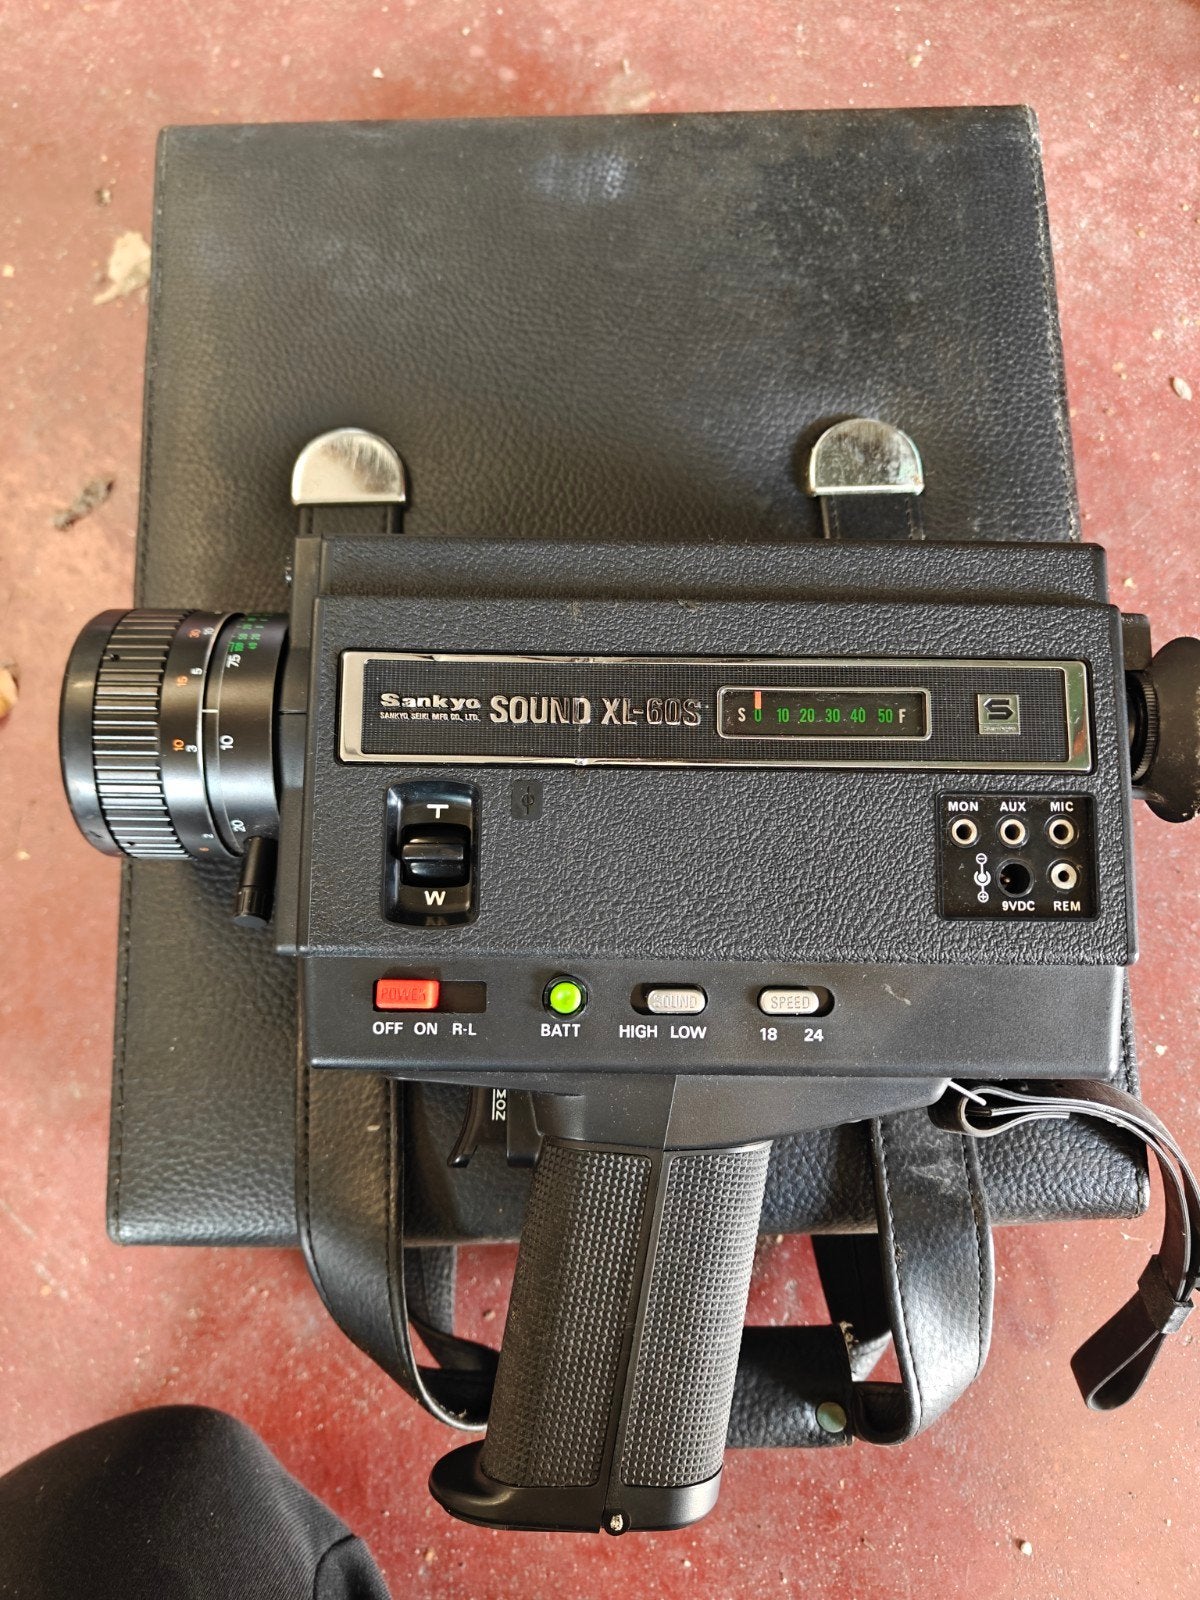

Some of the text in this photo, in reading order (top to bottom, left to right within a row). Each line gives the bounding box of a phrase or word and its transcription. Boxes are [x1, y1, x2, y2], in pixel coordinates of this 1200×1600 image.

[226, 653, 241, 668] 75
[380, 692, 702, 727] Sankyo SOUND XL-60S
[380, 711, 409, 720] SANKYO
[737, 707, 747, 722] S
[776, 708, 790, 723] 10
[799, 708, 816, 723] 20
[825, 708, 841, 723] 30
[849, 708, 867, 723] 40
[877, 708, 894, 723] 50
[898, 708, 907, 723] F
[173, 739, 198, 753] 10 3
[220, 735, 234, 751] 10
[426, 803, 450, 819] T
[948, 801, 1074, 812] MON AUX MIC
[230, 819, 247, 833] 20
[424, 890, 446, 906] W
[1001, 901, 1081, 911] 9VDC REM
[381, 987, 427, 1001] POWER
[653, 994, 698, 1010] SOUND
[770, 995, 811, 1010] SPEED
[372, 1021, 477, 1036] OFF ON R-L
[540, 1023, 581, 1038] BATT
[619, 1025, 707, 1039] HIGH LOW
[759, 1027, 824, 1042] 18 24
[495, 1088, 507, 1121] MON
